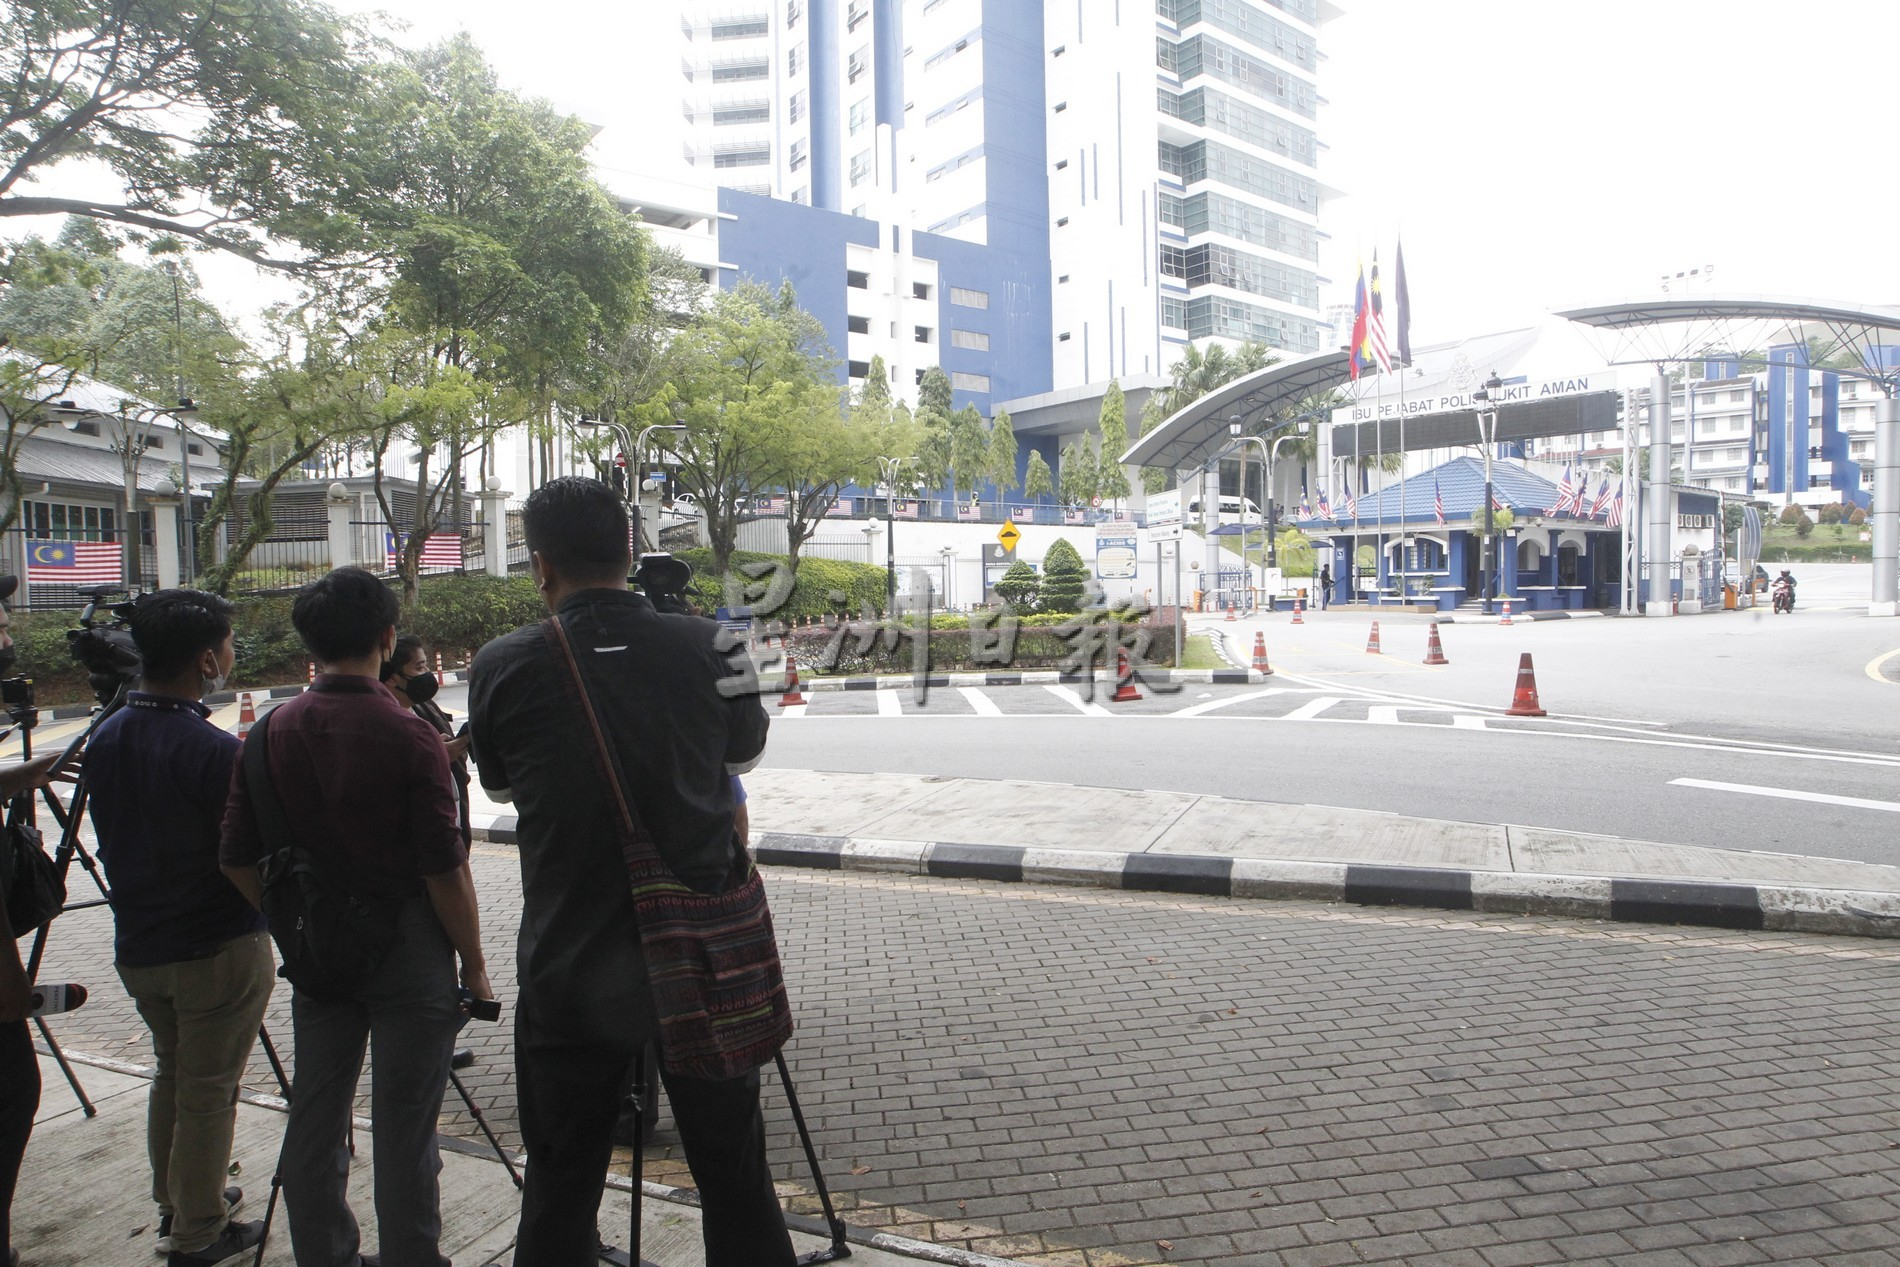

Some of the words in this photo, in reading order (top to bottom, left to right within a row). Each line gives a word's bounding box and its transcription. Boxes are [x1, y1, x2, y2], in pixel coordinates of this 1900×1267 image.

[1352, 408, 1371, 420] IBU
[1379, 399, 1434, 416] PEJABAT
[1497, 385, 1532, 401] UKIT
[1540, 377, 1589, 396] AMAN
